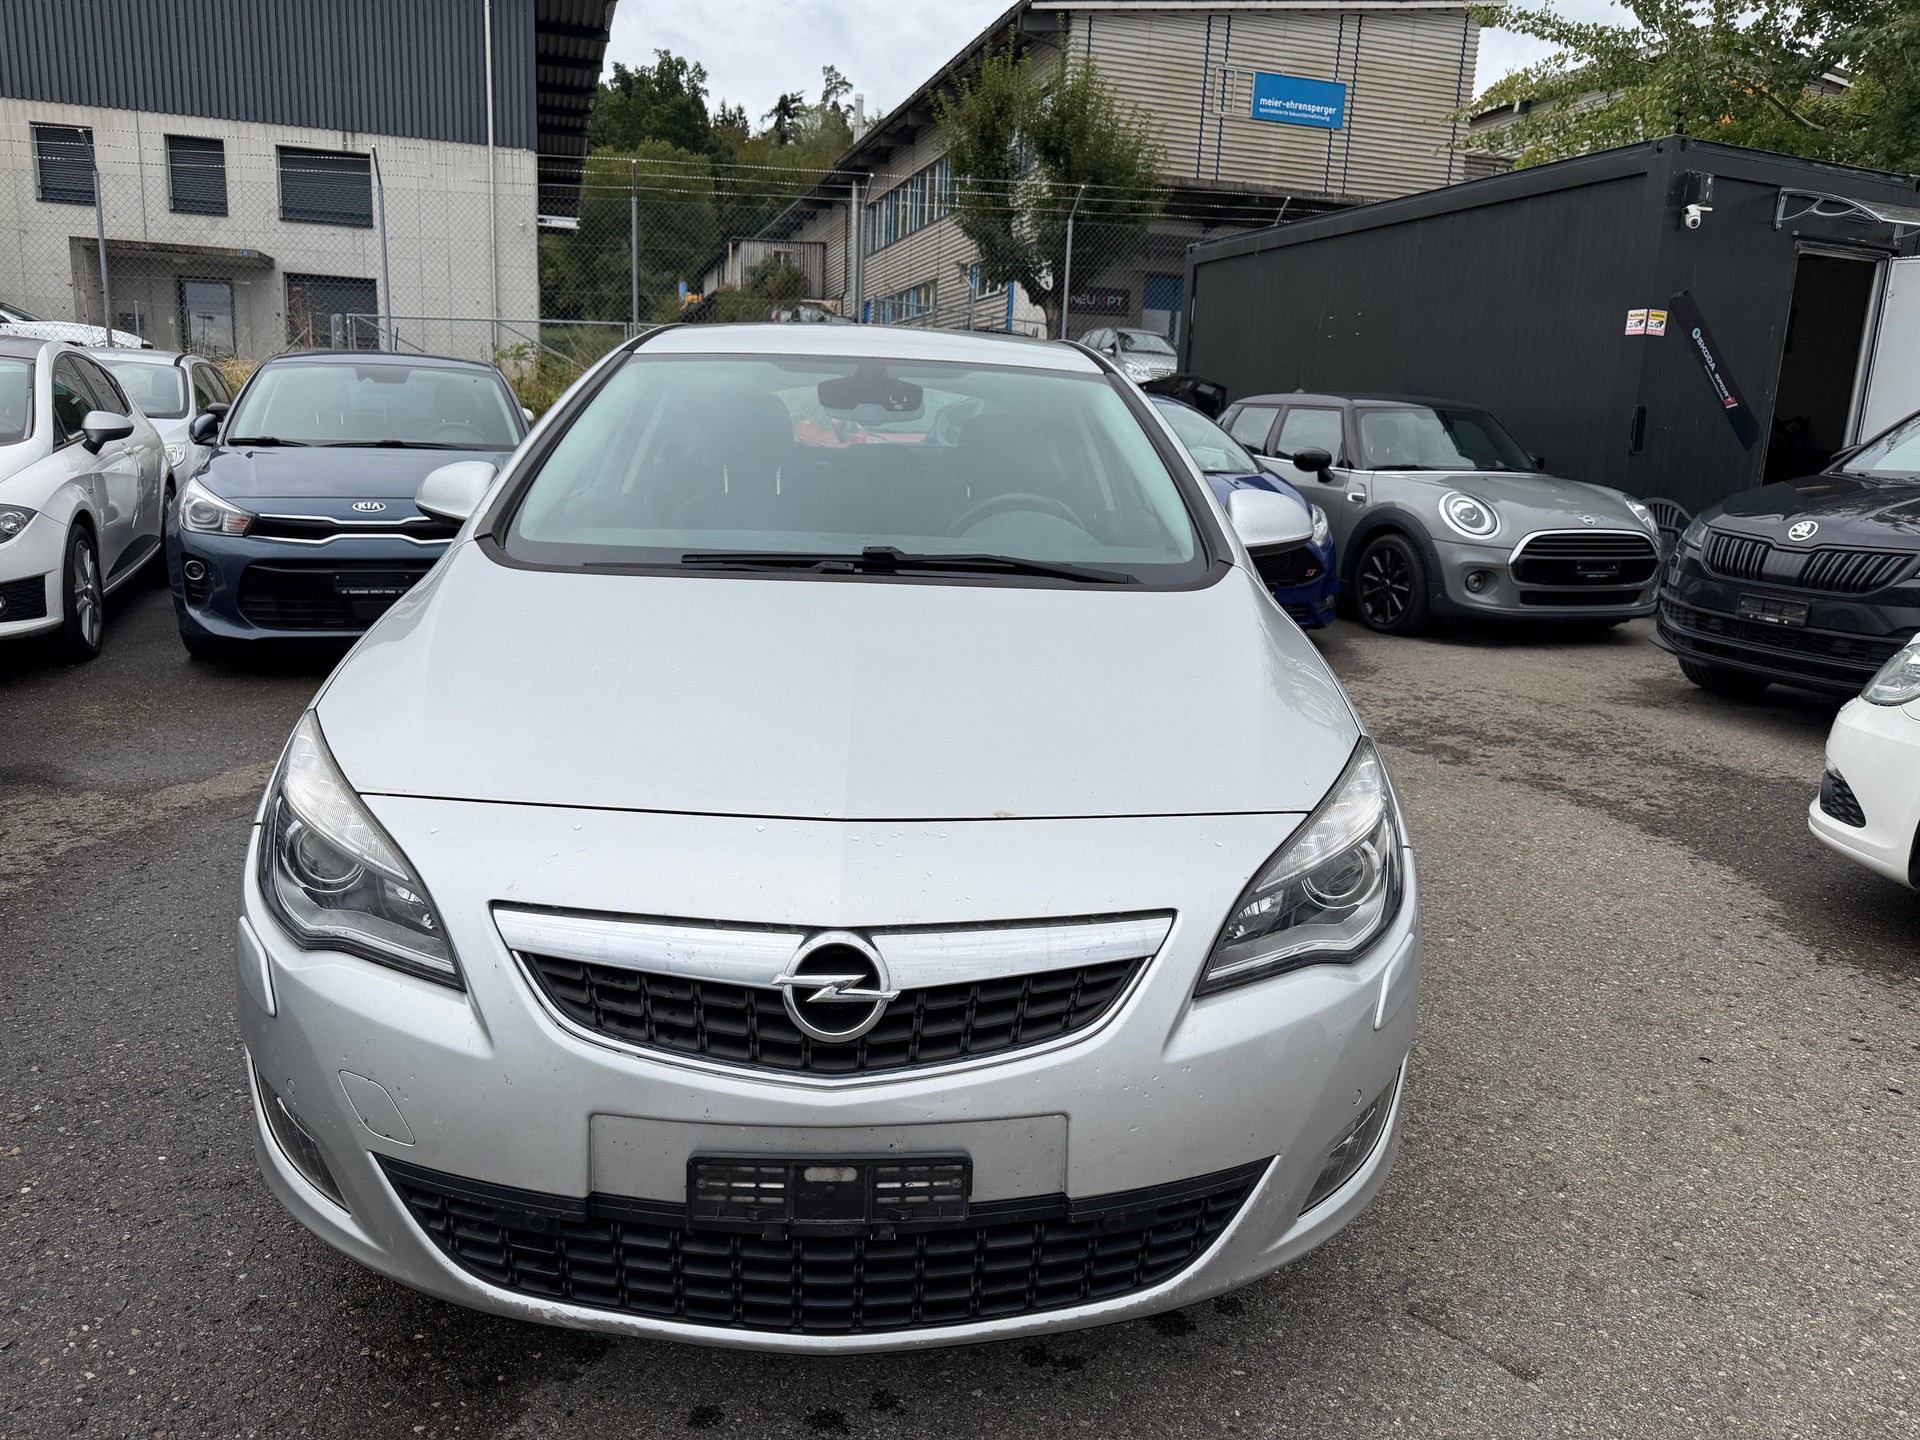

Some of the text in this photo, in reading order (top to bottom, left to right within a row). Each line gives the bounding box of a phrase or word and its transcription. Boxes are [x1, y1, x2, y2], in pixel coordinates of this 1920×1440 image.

[1259, 97, 1337, 115] meier-ehrensperger
[1714, 373, 1733, 403] SPORT
[356, 501, 383, 511] KIA
[805, 935, 869, 952] OPEL
